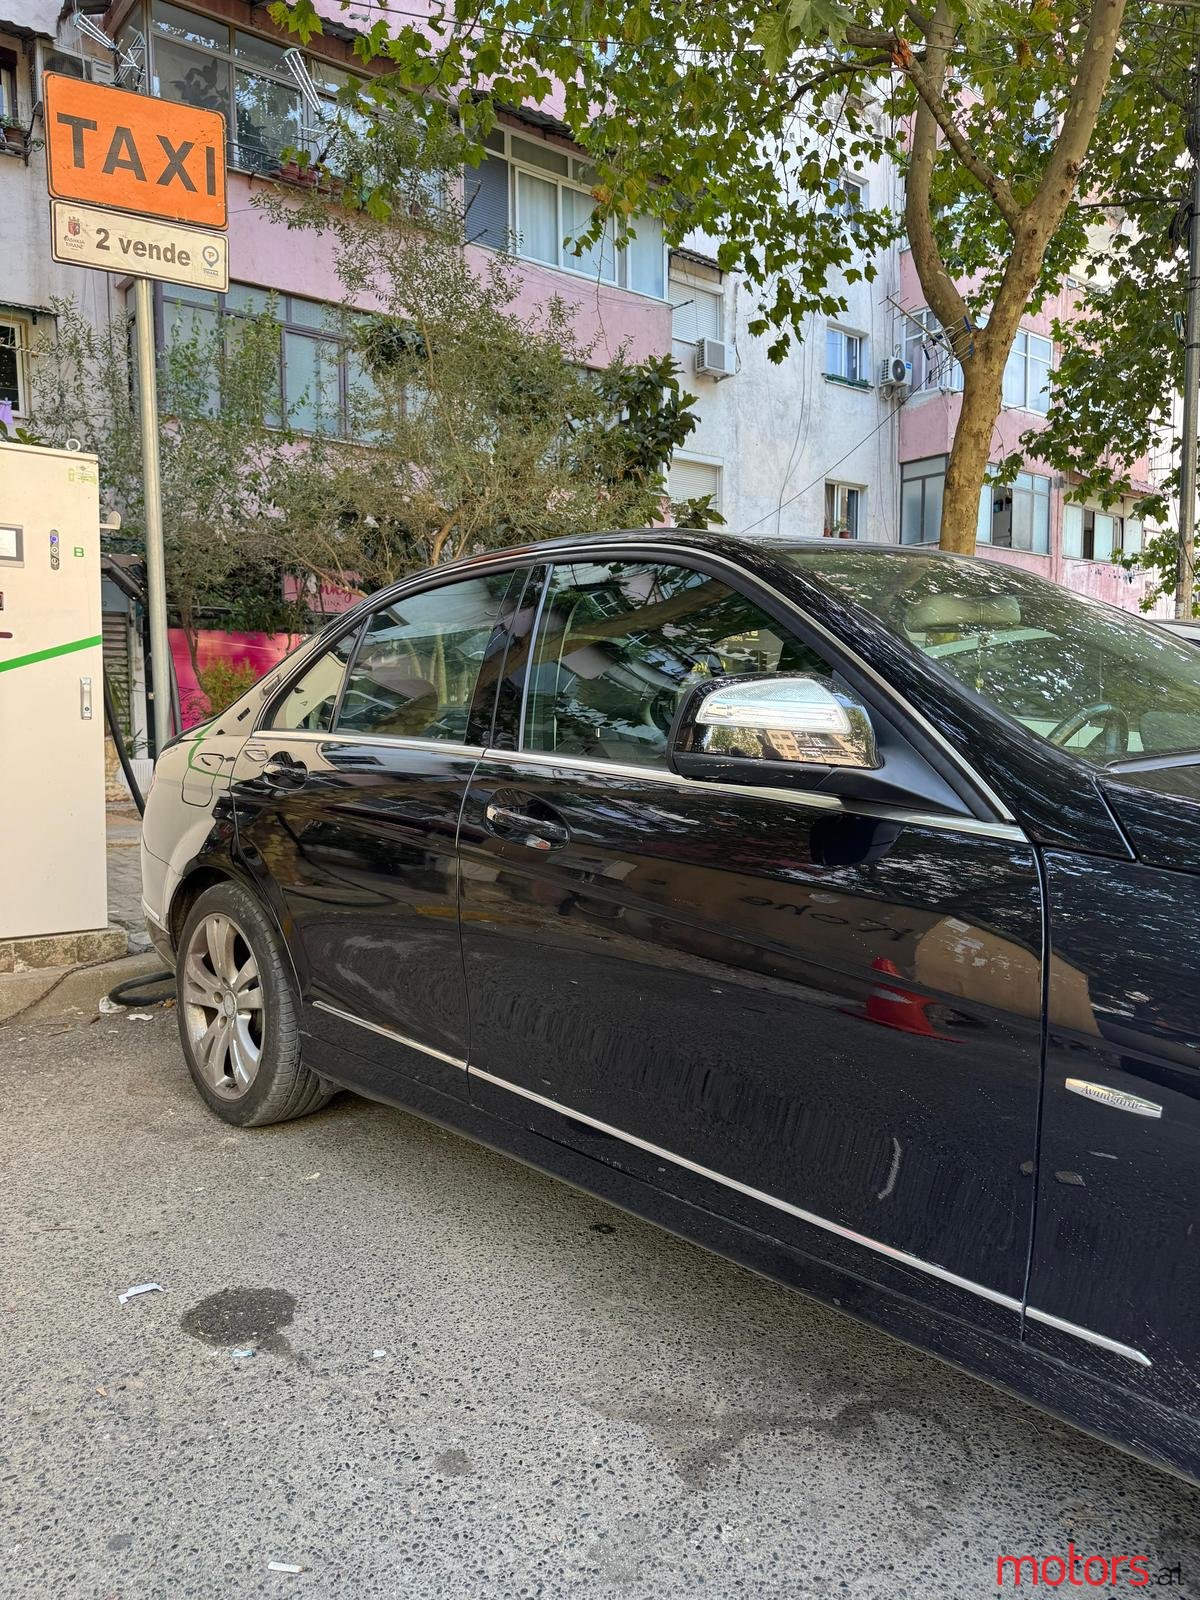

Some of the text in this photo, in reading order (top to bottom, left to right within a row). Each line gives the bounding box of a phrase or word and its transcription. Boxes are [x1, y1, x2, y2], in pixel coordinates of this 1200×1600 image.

[57, 112, 217, 197] TAXI
[96, 227, 191, 266] 2 vende
[74, 547, 85, 558] B
[1080, 1085, 1143, 1110] Avantgarde
